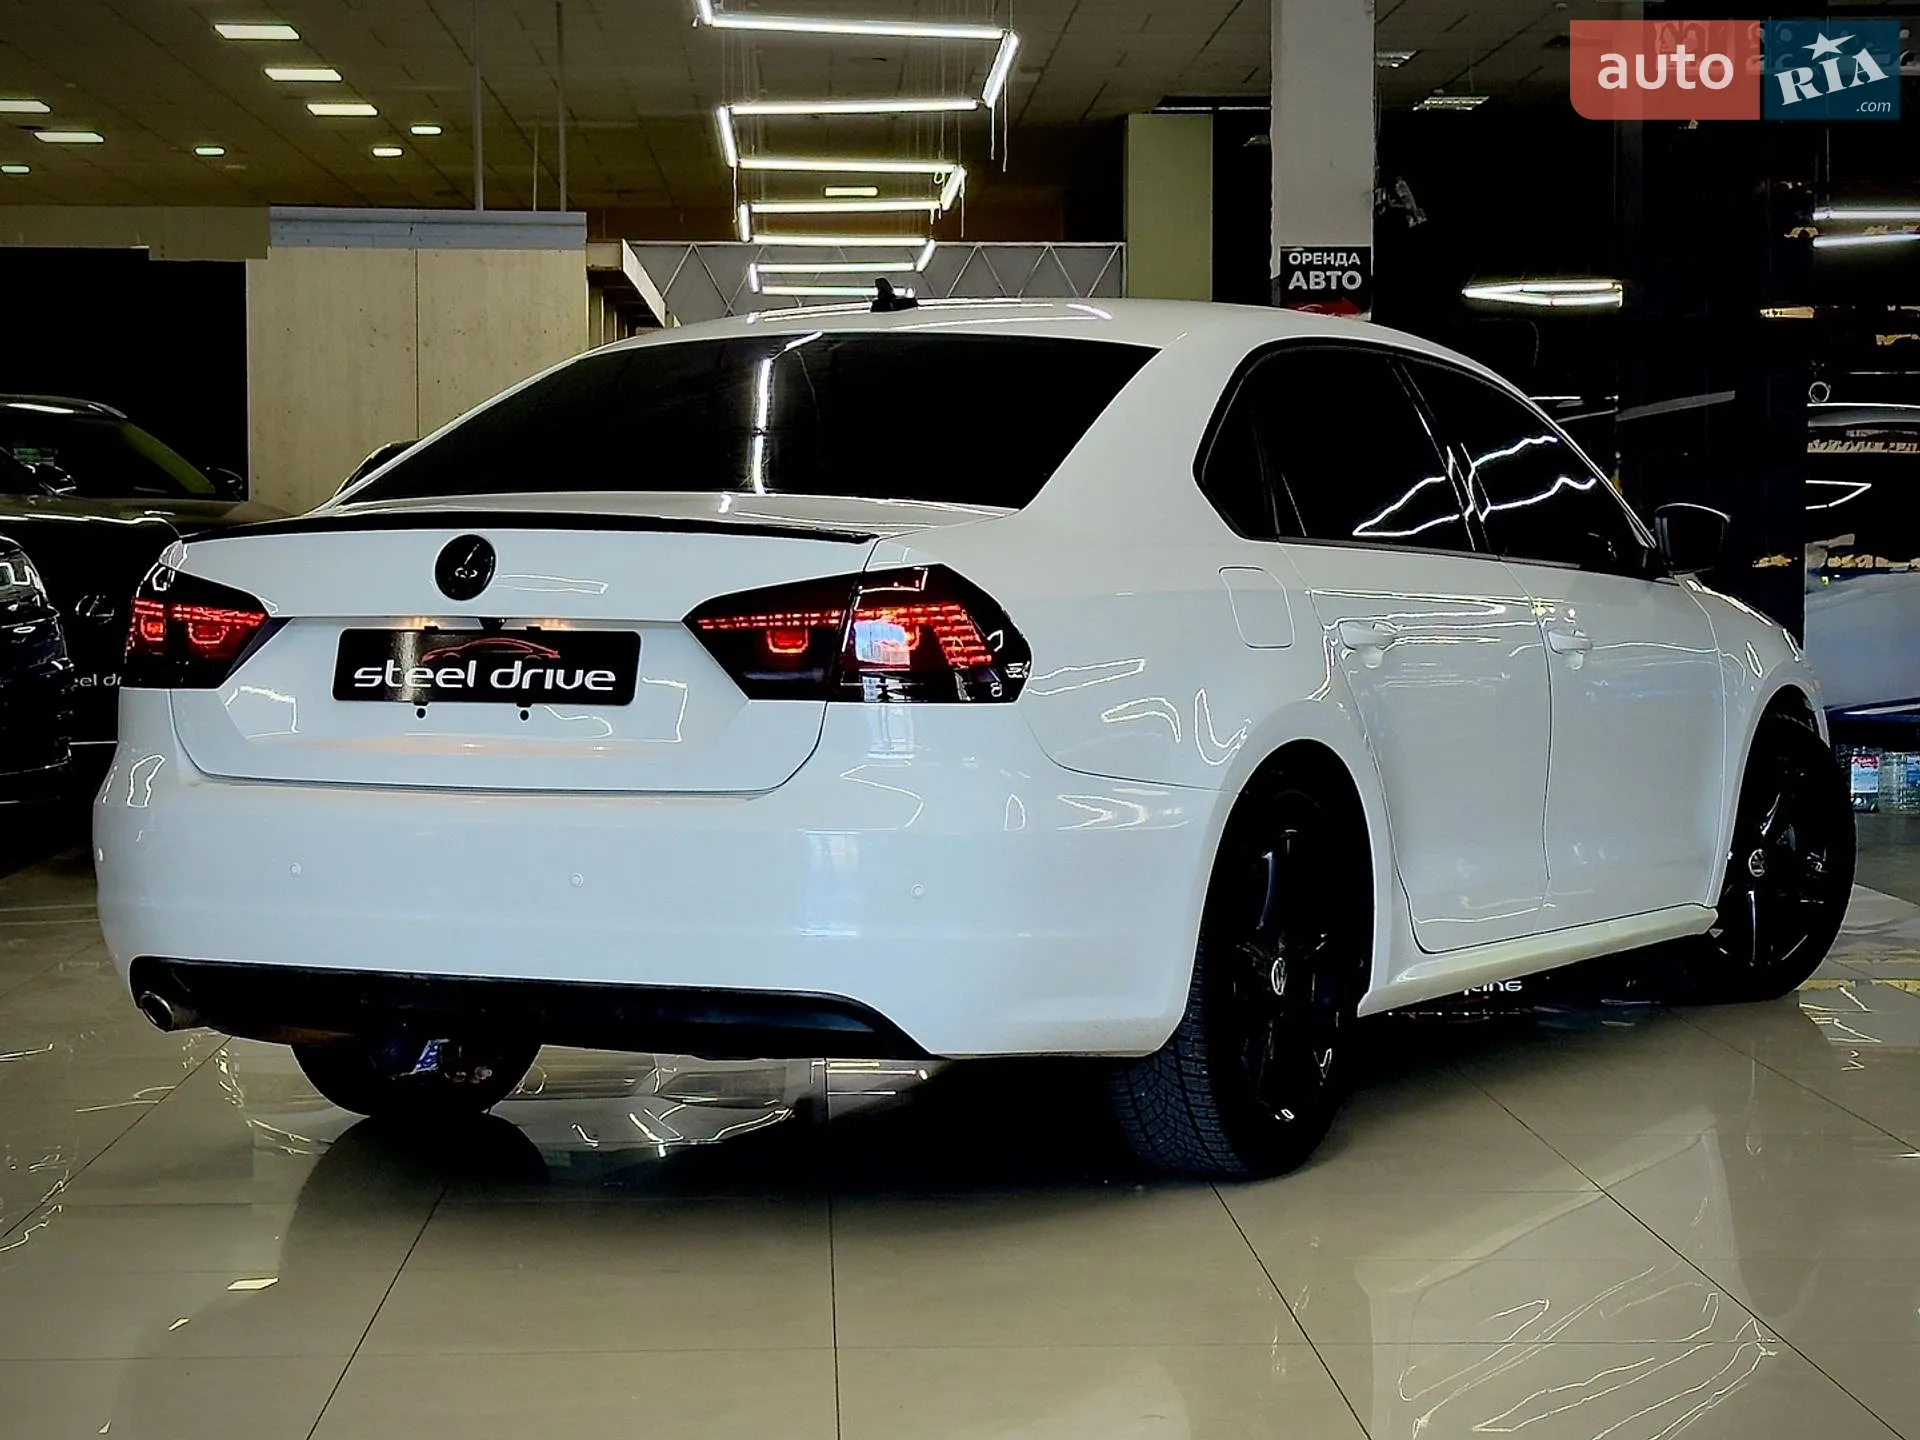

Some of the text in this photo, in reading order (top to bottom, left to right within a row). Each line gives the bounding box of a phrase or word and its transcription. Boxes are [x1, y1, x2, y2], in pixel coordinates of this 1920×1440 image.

[1288, 252, 1361, 267] ОРЕНДА
[1288, 270, 1362, 290] АВТО
[354, 660, 616, 690] steel drive
